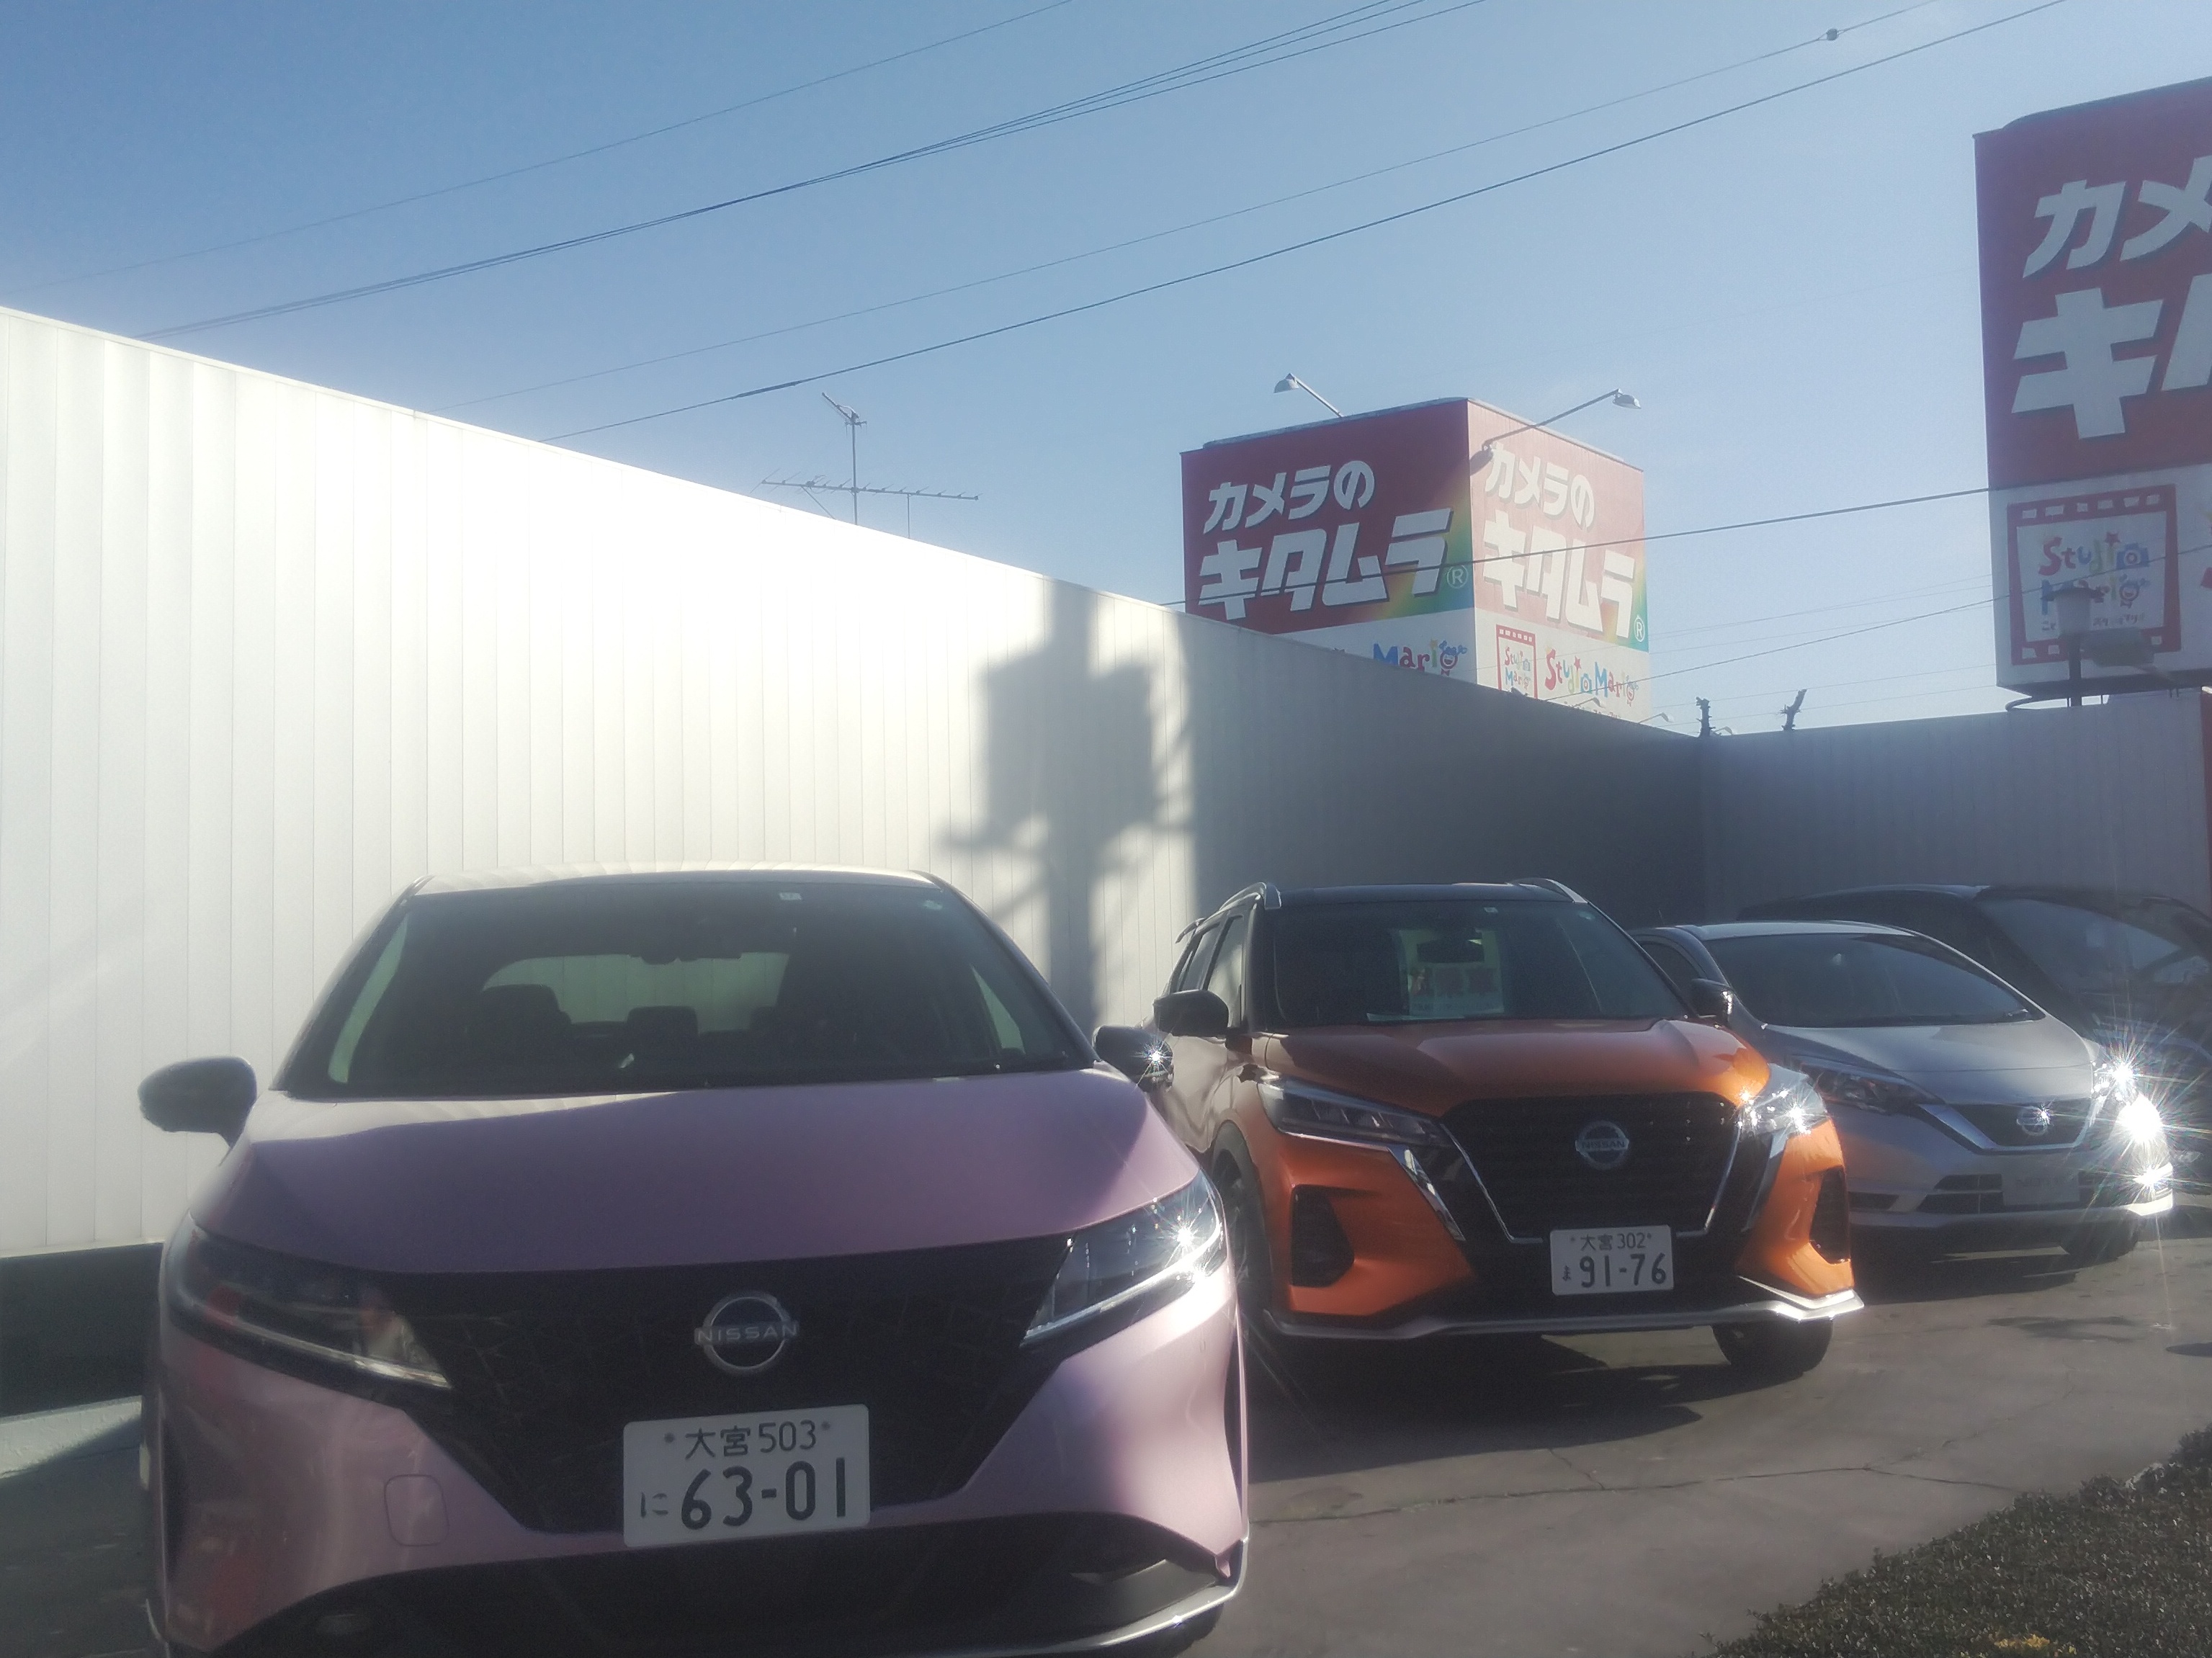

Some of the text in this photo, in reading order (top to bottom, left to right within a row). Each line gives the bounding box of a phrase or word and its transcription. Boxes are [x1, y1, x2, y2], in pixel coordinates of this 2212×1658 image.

[1203, 460, 1375, 534] カメラの
[1485, 442, 1595, 528] カメラの
[1198, 508, 1451, 620] キタムラ
[1483, 509, 1634, 638] キタムラ
[1579, 1252, 1667, 1289] 91-76
[696, 1322, 798, 1344] NISSAN
[640, 1456, 846, 1531] に 63-01
